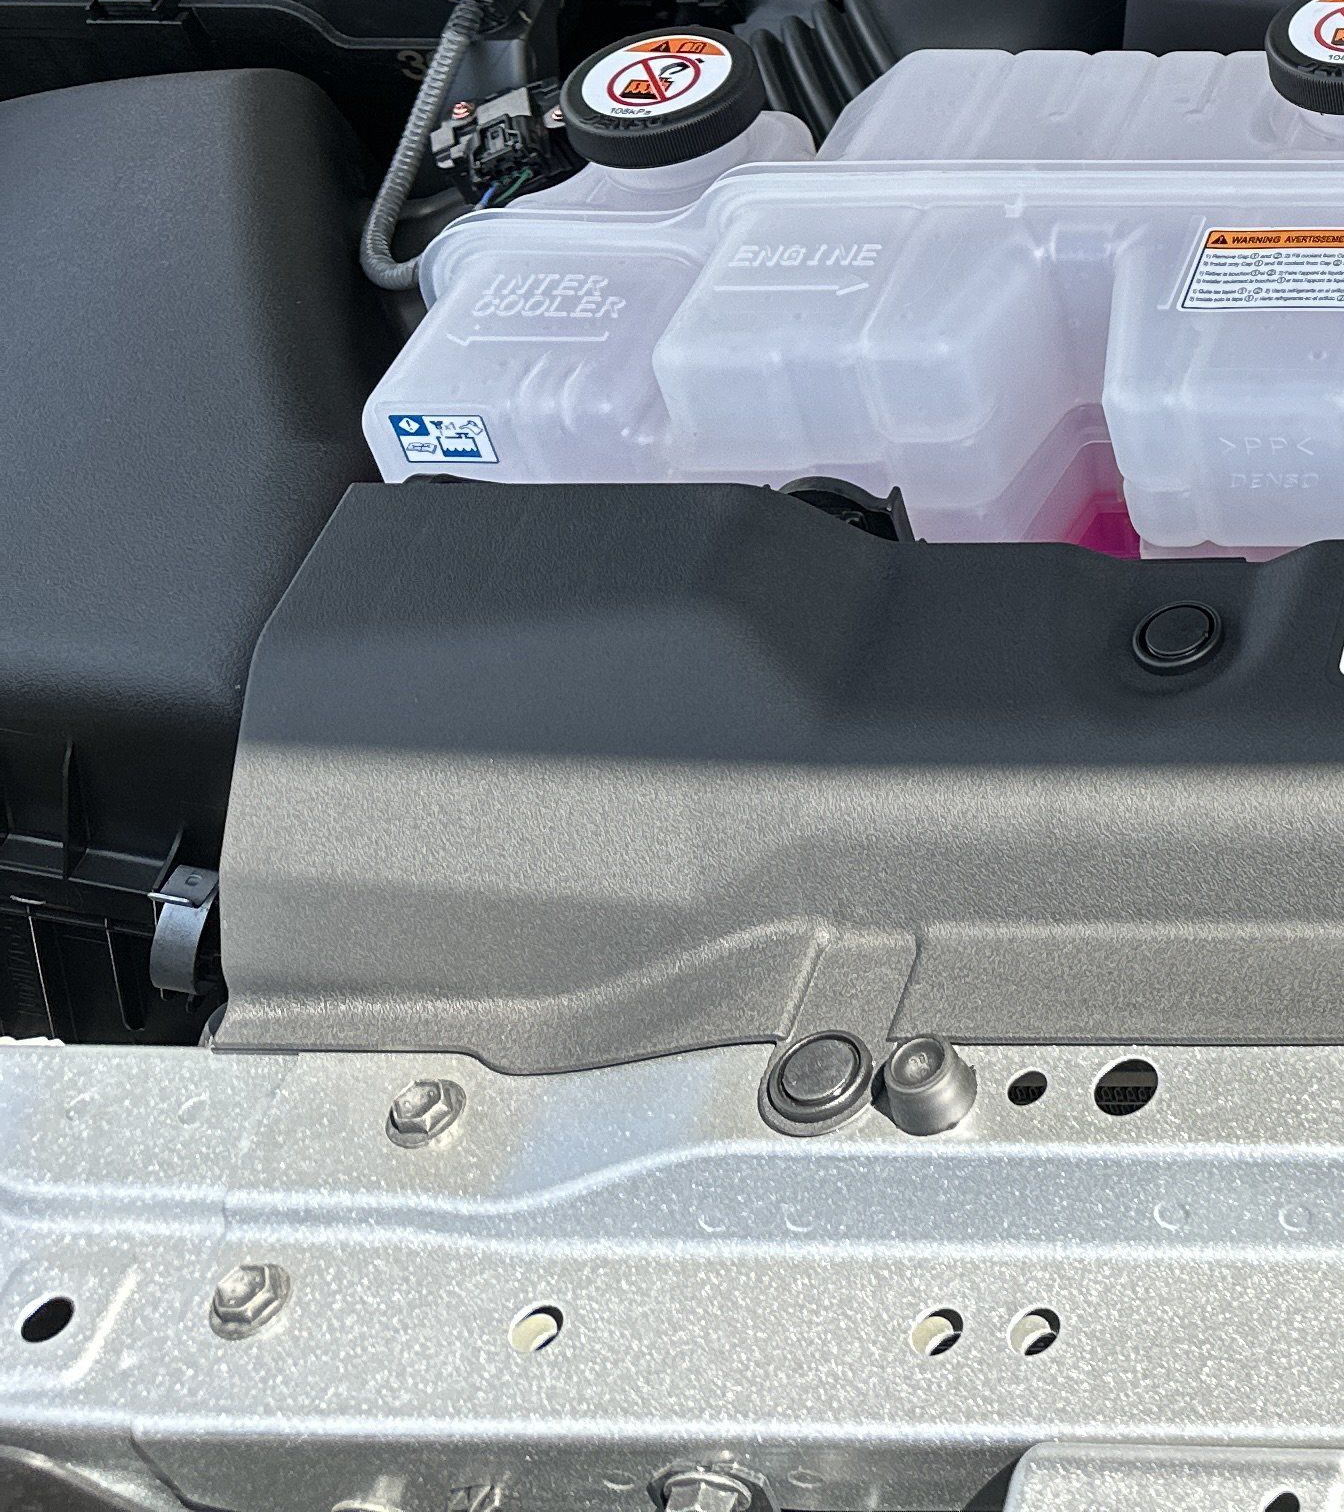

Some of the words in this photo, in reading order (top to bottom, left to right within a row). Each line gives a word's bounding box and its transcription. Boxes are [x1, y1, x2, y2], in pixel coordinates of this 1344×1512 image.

[1231, 235, 1281, 244] WARNING
[728, 243, 883, 268] ENGINE
[482, 273, 609, 296] INTER
[471, 295, 627, 319] COOLER
